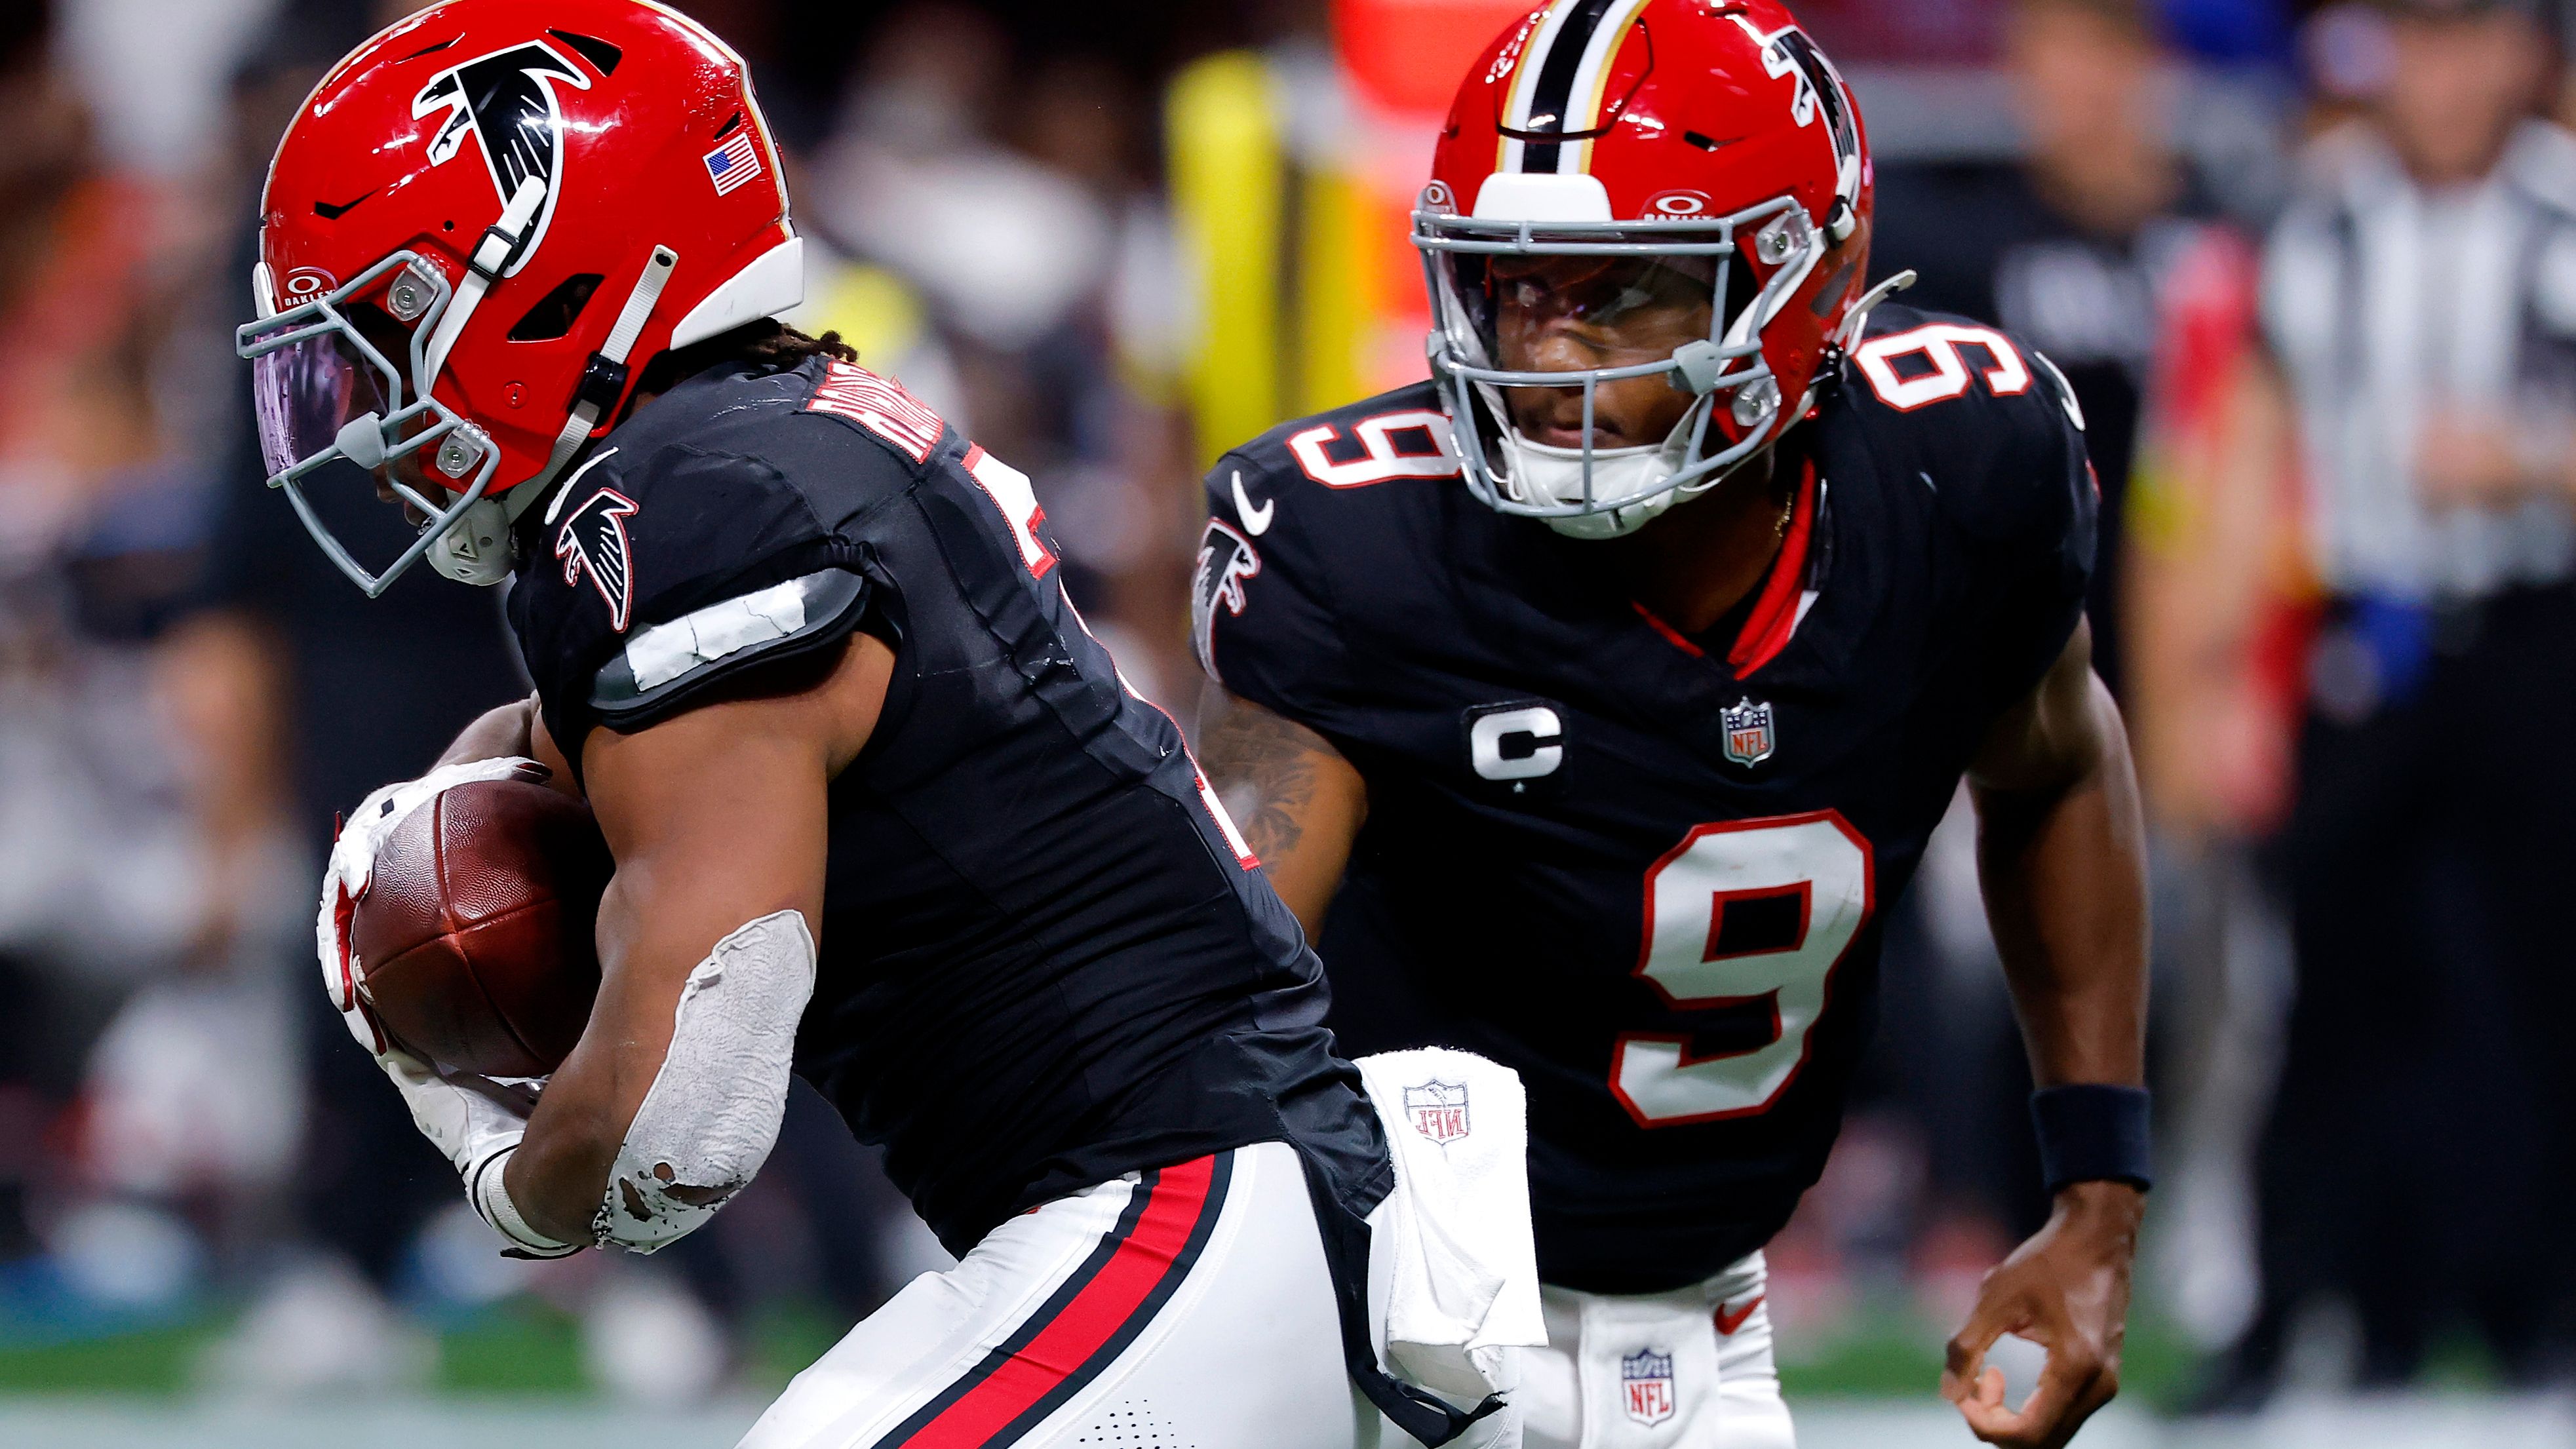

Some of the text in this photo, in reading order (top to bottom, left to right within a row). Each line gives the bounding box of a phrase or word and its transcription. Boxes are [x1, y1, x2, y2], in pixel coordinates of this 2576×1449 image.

[284, 289, 336, 307] OAKLEY
[1851, 321, 2032, 414] 9
[1285, 408, 1462, 489] 9
[1471, 707, 1563, 781] C
[1732, 731, 1768, 756] NFL
[1607, 807, 1875, 1130] 9
[1630, 1382, 1669, 1417] NFL
